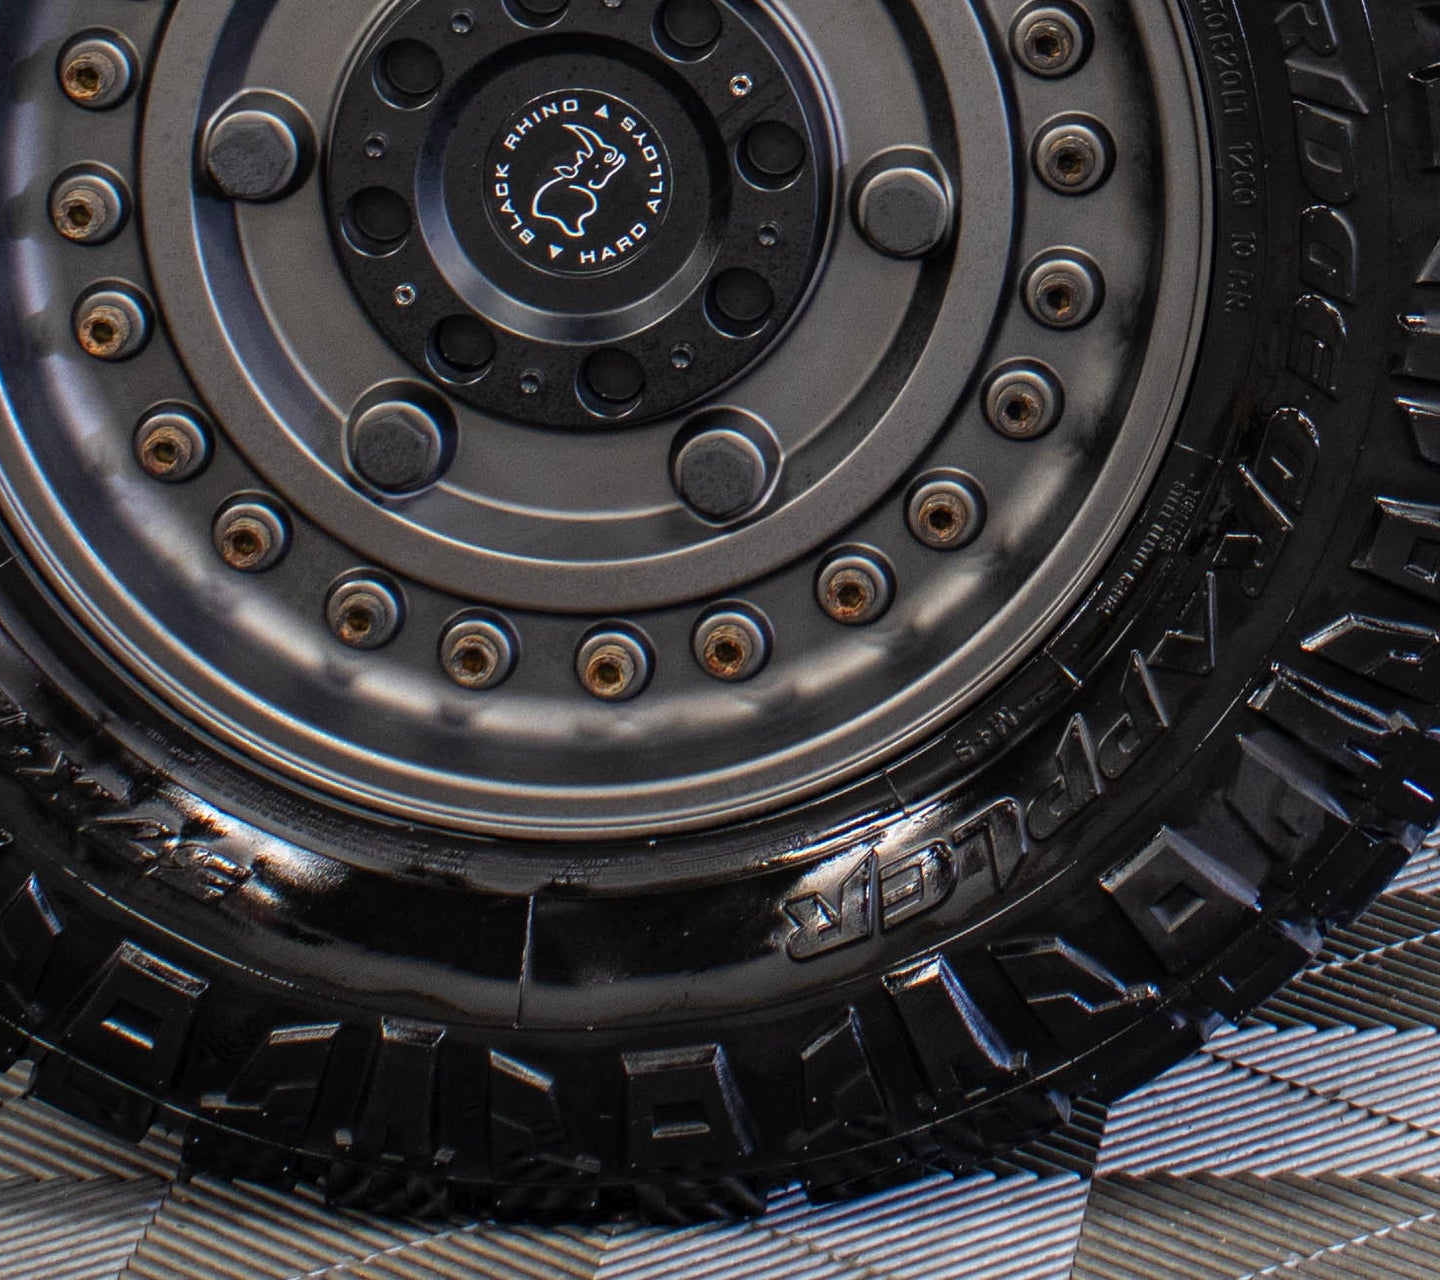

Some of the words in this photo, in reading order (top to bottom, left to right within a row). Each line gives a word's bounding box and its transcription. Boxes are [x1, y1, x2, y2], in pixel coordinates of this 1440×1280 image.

[503, 99, 580, 151] RHINO
[495, 163, 536, 245] BLACK
[580, 222, 648, 264] HARD
[620, 116, 663, 215] ALLOYS
[781, 403, 1323, 963] GRAPPLER
